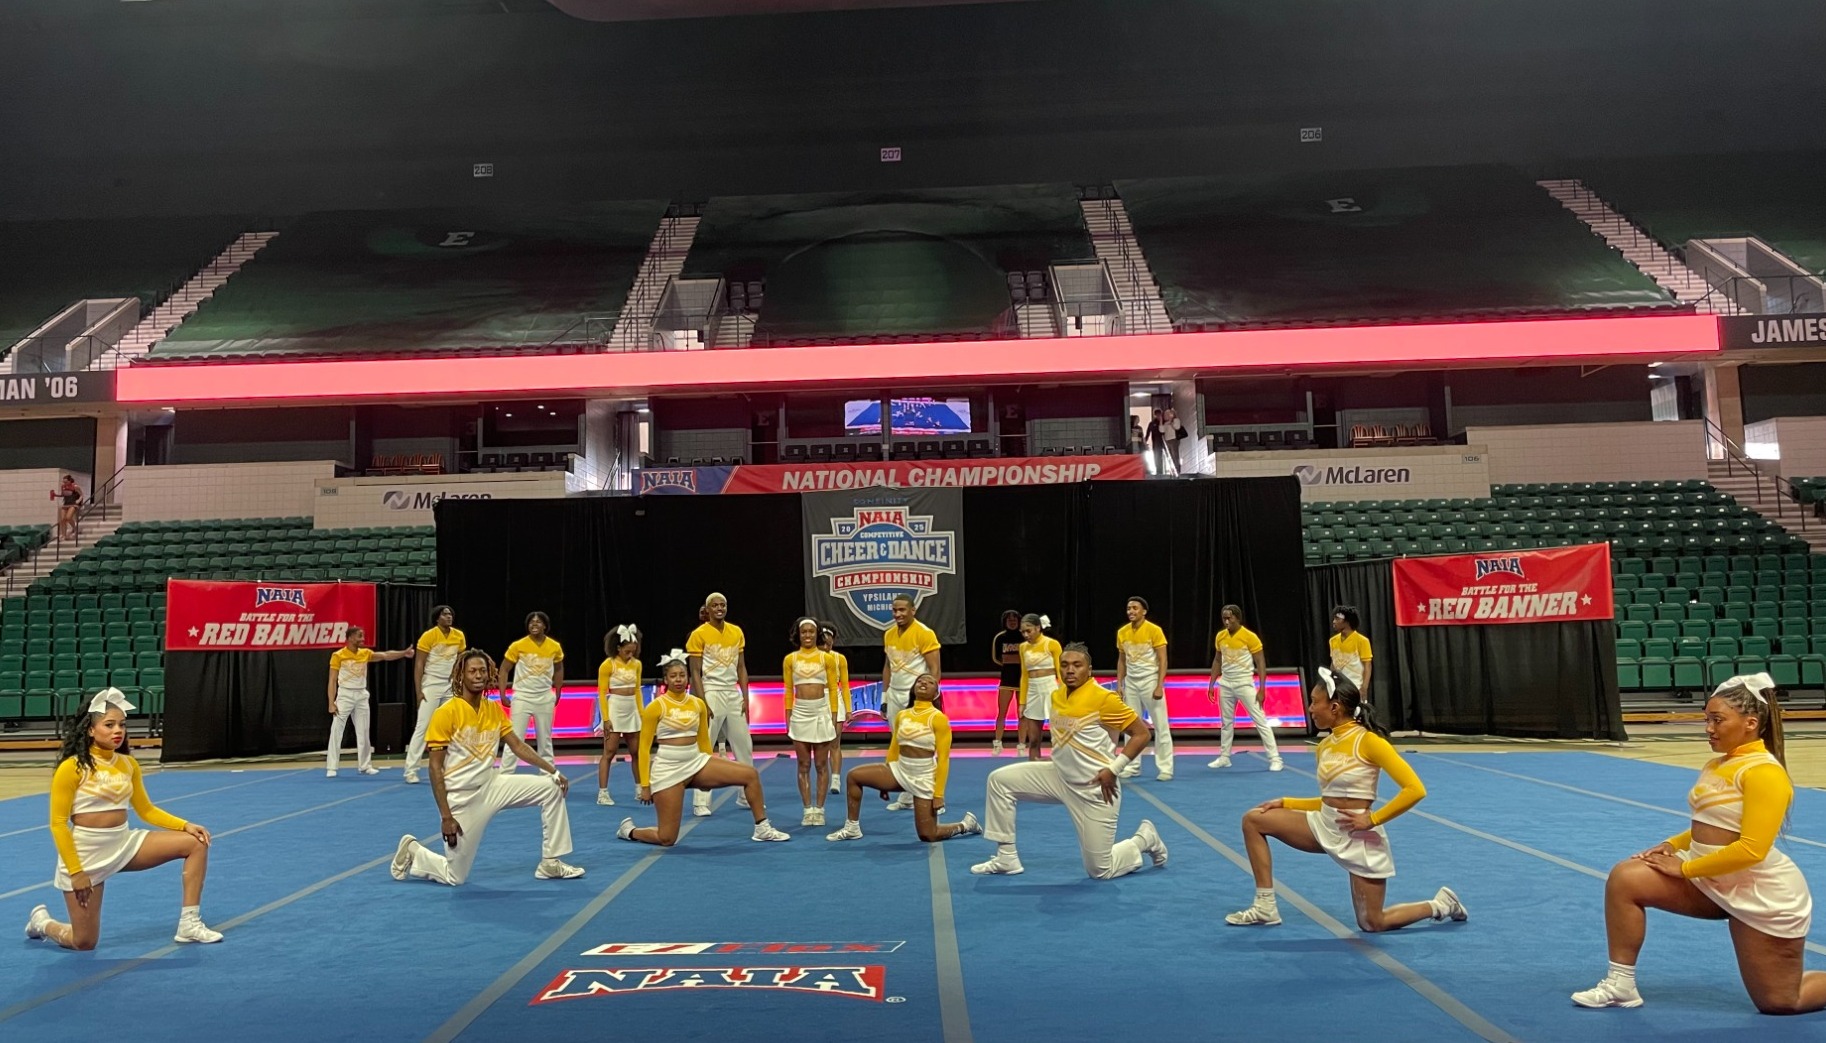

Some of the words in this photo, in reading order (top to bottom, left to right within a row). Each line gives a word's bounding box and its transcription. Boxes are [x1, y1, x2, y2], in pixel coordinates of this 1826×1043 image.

[1301, 130, 1321, 140] 206
[882, 150, 900, 160] 207
[1324, 198, 1362, 213] E
[439, 232, 475, 246] E
[0, 378, 36, 400] AN
[45, 376, 78, 398] '06
[641, 470, 696, 492] NAIA
[782, 468, 901, 489] NATIONAL
[908, 463, 1100, 487] CHAMPIONSHIP
[1325, 466, 1410, 485] McLaren
[858, 511, 905, 528] NAIA
[841, 525, 851, 533] 20
[860, 531, 904, 539] COMPETITIVE
[1475, 557, 1525, 580] NAIA
[837, 572, 931, 588] CHAMPIONSHIP
[863, 592, 902, 602] YPSILAN
[1461, 585, 1497, 596] BATTLE
[1498, 584, 1516, 594] FOR
[1518, 583, 1538, 593] THE
[255, 588, 306, 608] NAIA
[1427, 597, 1473, 620] RED
[1474, 591, 1578, 619] BANNER
[867, 603, 894, 611] MICHIG
[239, 612, 276, 622] BATTLE
[276, 612, 296, 622] FOR
[297, 612, 315, 622] THE
[199, 622, 250, 646] RED
[251, 621, 349, 645] BANNER
[534, 966, 881, 1003] NAIA
